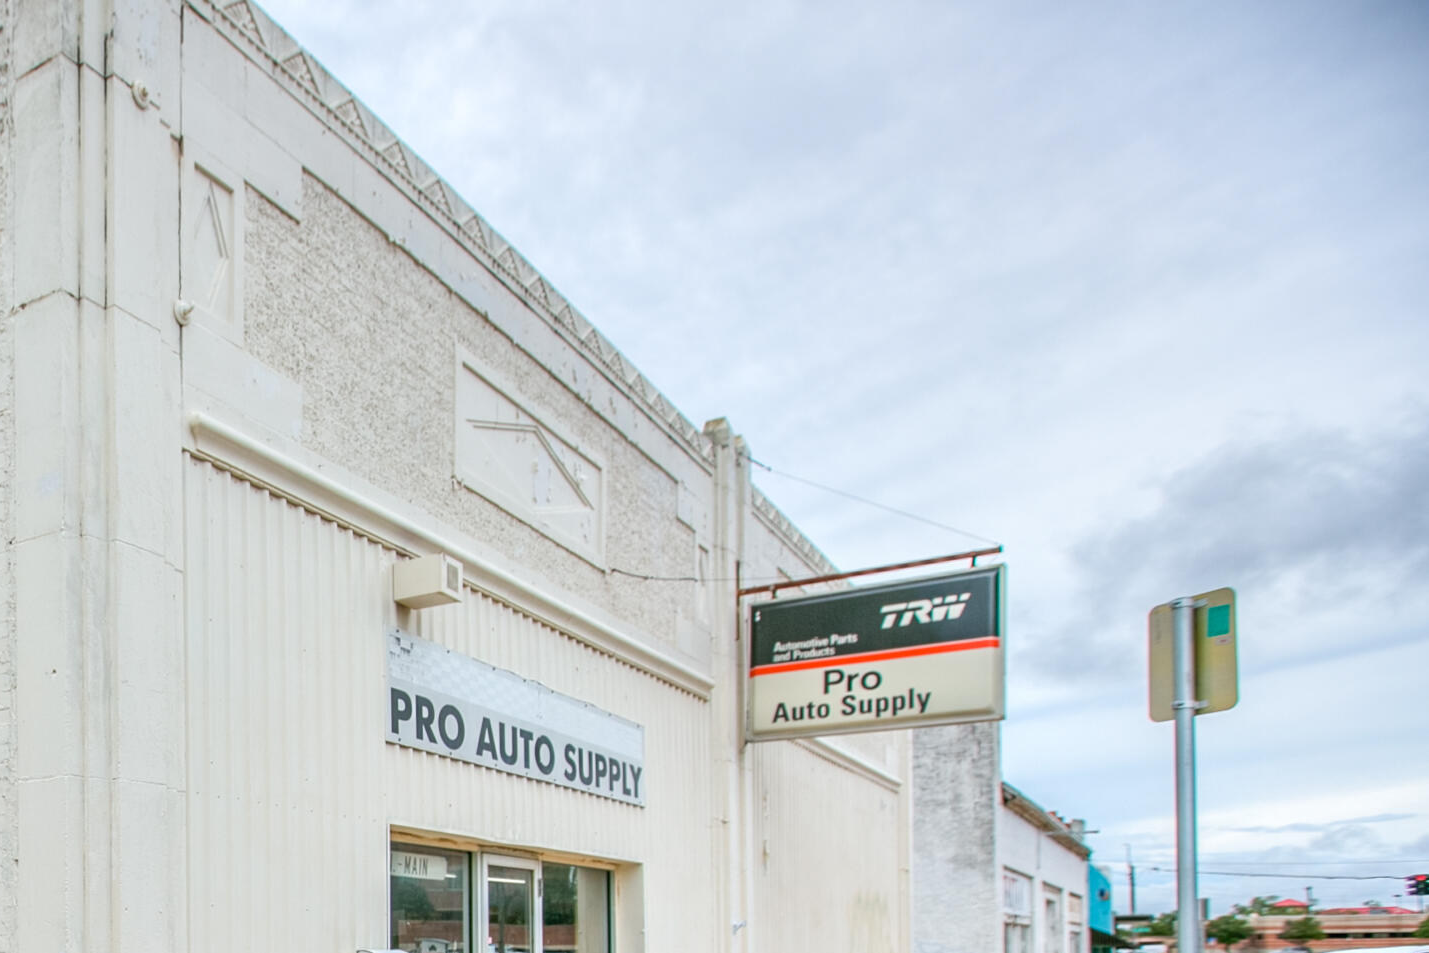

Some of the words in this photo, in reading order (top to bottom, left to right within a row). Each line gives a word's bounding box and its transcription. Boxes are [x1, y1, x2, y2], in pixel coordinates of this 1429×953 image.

[880, 593, 971, 629] TRW
[773, 636, 829, 652] Automotive
[830, 633, 858, 645] Parts
[773, 651, 791, 662] and
[792, 647, 835, 660] Products
[823, 669, 882, 694] Pro
[772, 702, 830, 724] Auto
[841, 688, 931, 718] Supply
[390, 687, 465, 750] PRO
[476, 717, 555, 775] AUTO
[564, 743, 642, 798] SUPPLY
